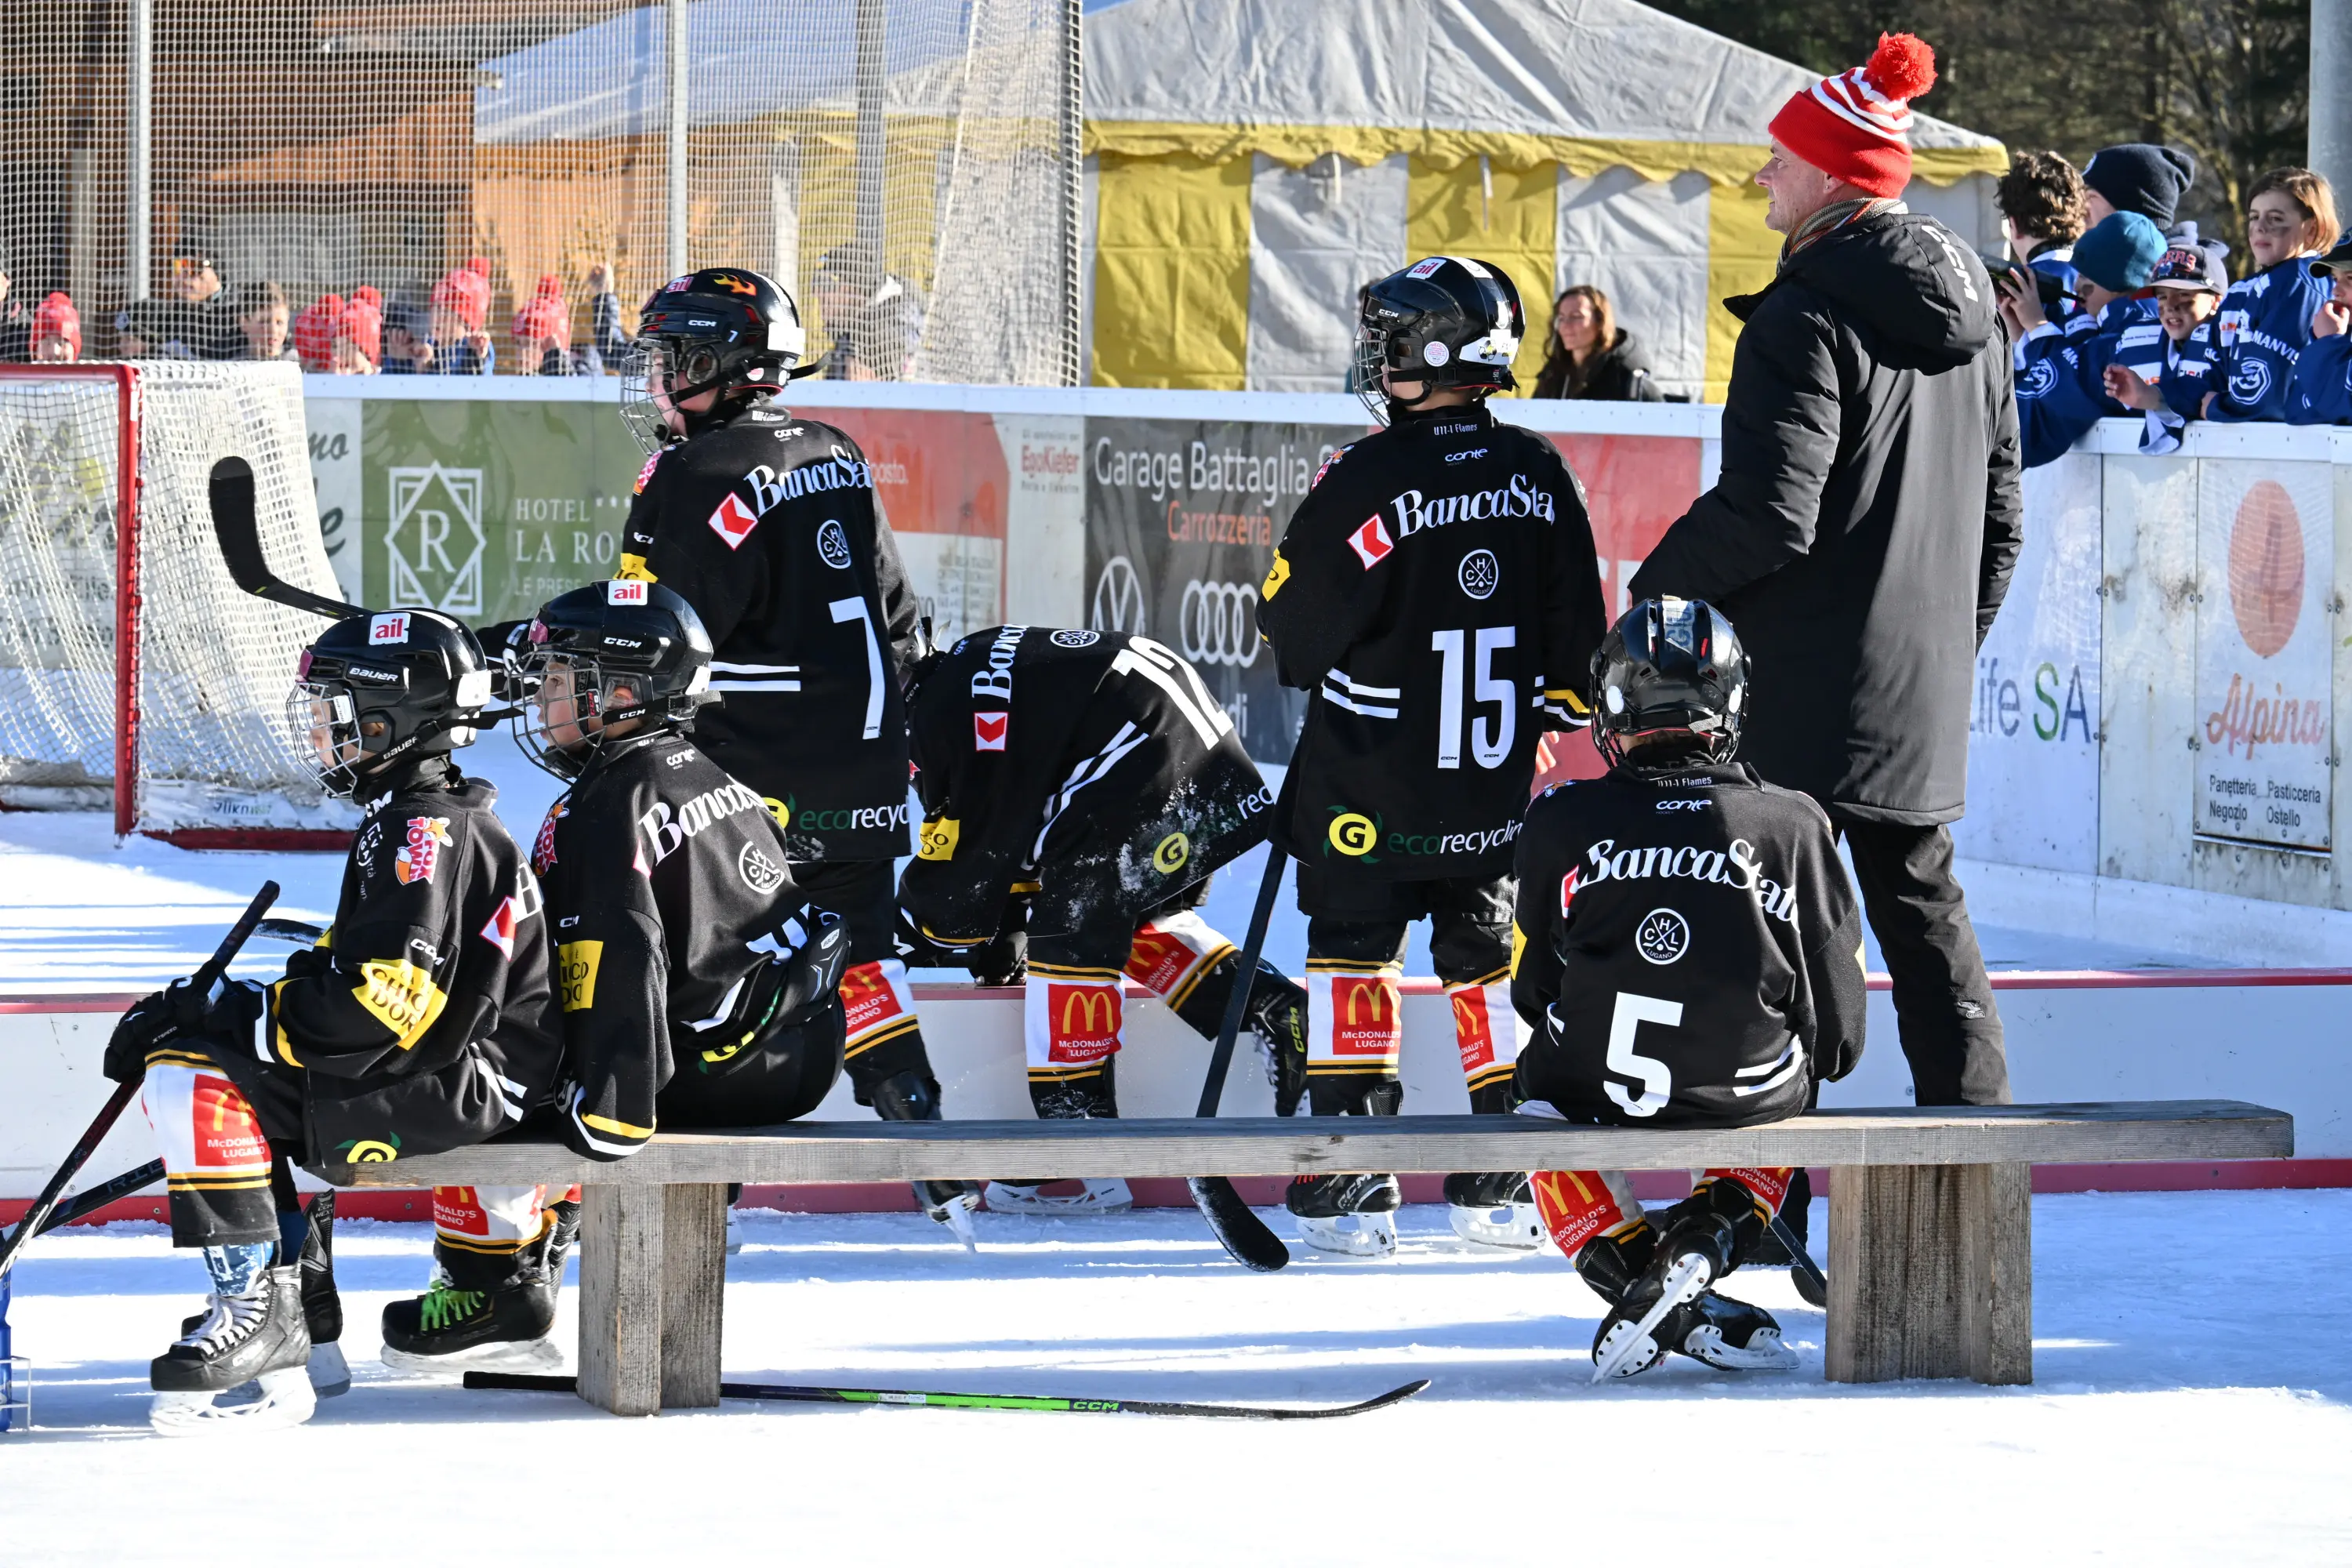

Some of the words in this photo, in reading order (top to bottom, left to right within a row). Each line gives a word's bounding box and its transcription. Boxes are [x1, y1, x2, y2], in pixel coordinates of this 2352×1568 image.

[1413, 262, 1436, 275] ail
[1922, 225, 1978, 303] CCM
[1378, 308, 1399, 318] CCM
[1455, 423, 1478, 434] Flames
[1445, 448, 1488, 462] conte
[1095, 437, 1184, 503] Garage
[1190, 441, 1309, 508] Battaglia
[515, 498, 591, 522] HOTEL
[1390, 474, 1555, 540] BancaSta
[1167, 500, 1272, 546] Carrozzeria
[415, 509, 457, 574] R
[514, 529, 557, 564] LA
[572, 530, 623, 564] RO
[514, 578, 532, 596] LE
[613, 584, 641, 600] ail
[375, 619, 404, 639] ail
[604, 637, 642, 648] CCM
[828, 596, 886, 739] 7
[1431, 626, 1515, 769] 15
[1969, 657, 2020, 737] ife
[2034, 662, 2092, 744] SA
[619, 709, 646, 720] CCM
[2205, 672, 2325, 760] Alpina
[1682, 776, 1712, 786] Flames
[2209, 774, 2257, 797] Panetteria
[2267, 780, 2321, 804] Pasticceria
[1656, 800, 1712, 811] conte
[2209, 800, 2248, 823] Negozio
[2267, 806, 2301, 828] Ostello
[1386, 819, 1523, 855] ecorecyclin
[1646, 948, 1673, 960] LUGANO
[1290, 1006, 1305, 1054] CCM
[1355, 1040, 1396, 1048] LUGANO
[1602, 991, 1684, 1118] 5
[207, 1134, 266, 1149] McDONALD
[222, 1145, 265, 1159] LUGANO
[434, 1210, 465, 1225] GANO
[1563, 1218, 1599, 1248] LUGANO
[1073, 1400, 1120, 1411] CCM
